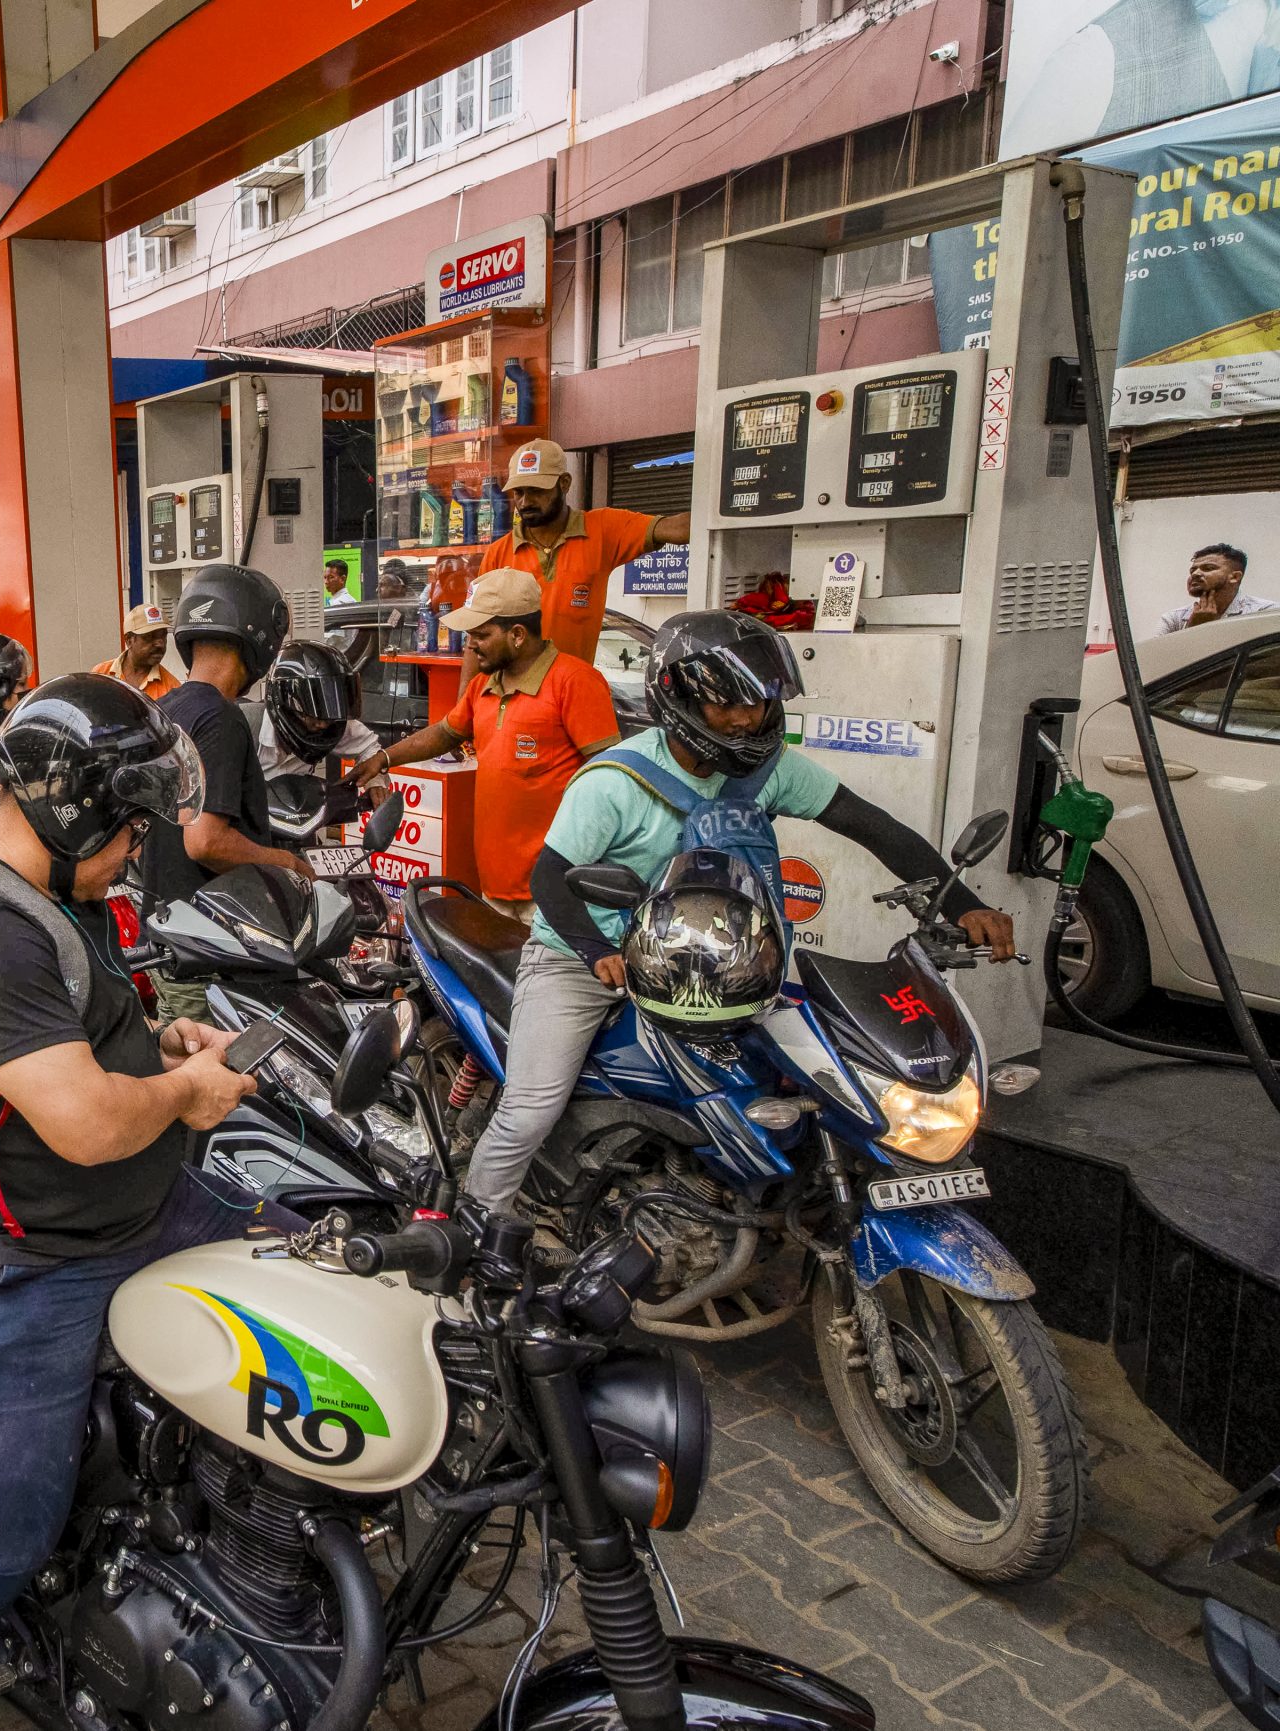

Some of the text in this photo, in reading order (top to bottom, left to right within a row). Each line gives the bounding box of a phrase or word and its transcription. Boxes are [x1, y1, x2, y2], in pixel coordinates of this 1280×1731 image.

[1134, 163, 1203, 199] our
[1192, 239, 1206, 252] to
[1210, 231, 1244, 249] 1950
[484, 276, 524, 296] LUBRICANTS
[492, 292, 522, 306] EXTREME
[967, 313, 979, 322] or
[900, 377, 920, 385] BEFORE
[921, 373, 946, 381] DELIVERY
[1127, 388, 1186, 405] 1950
[818, 716, 922, 746] DIESEL
[908, 1054, 951, 1066] HONDA
[317, 1394, 370, 1412] ROYAL ENFIELD
